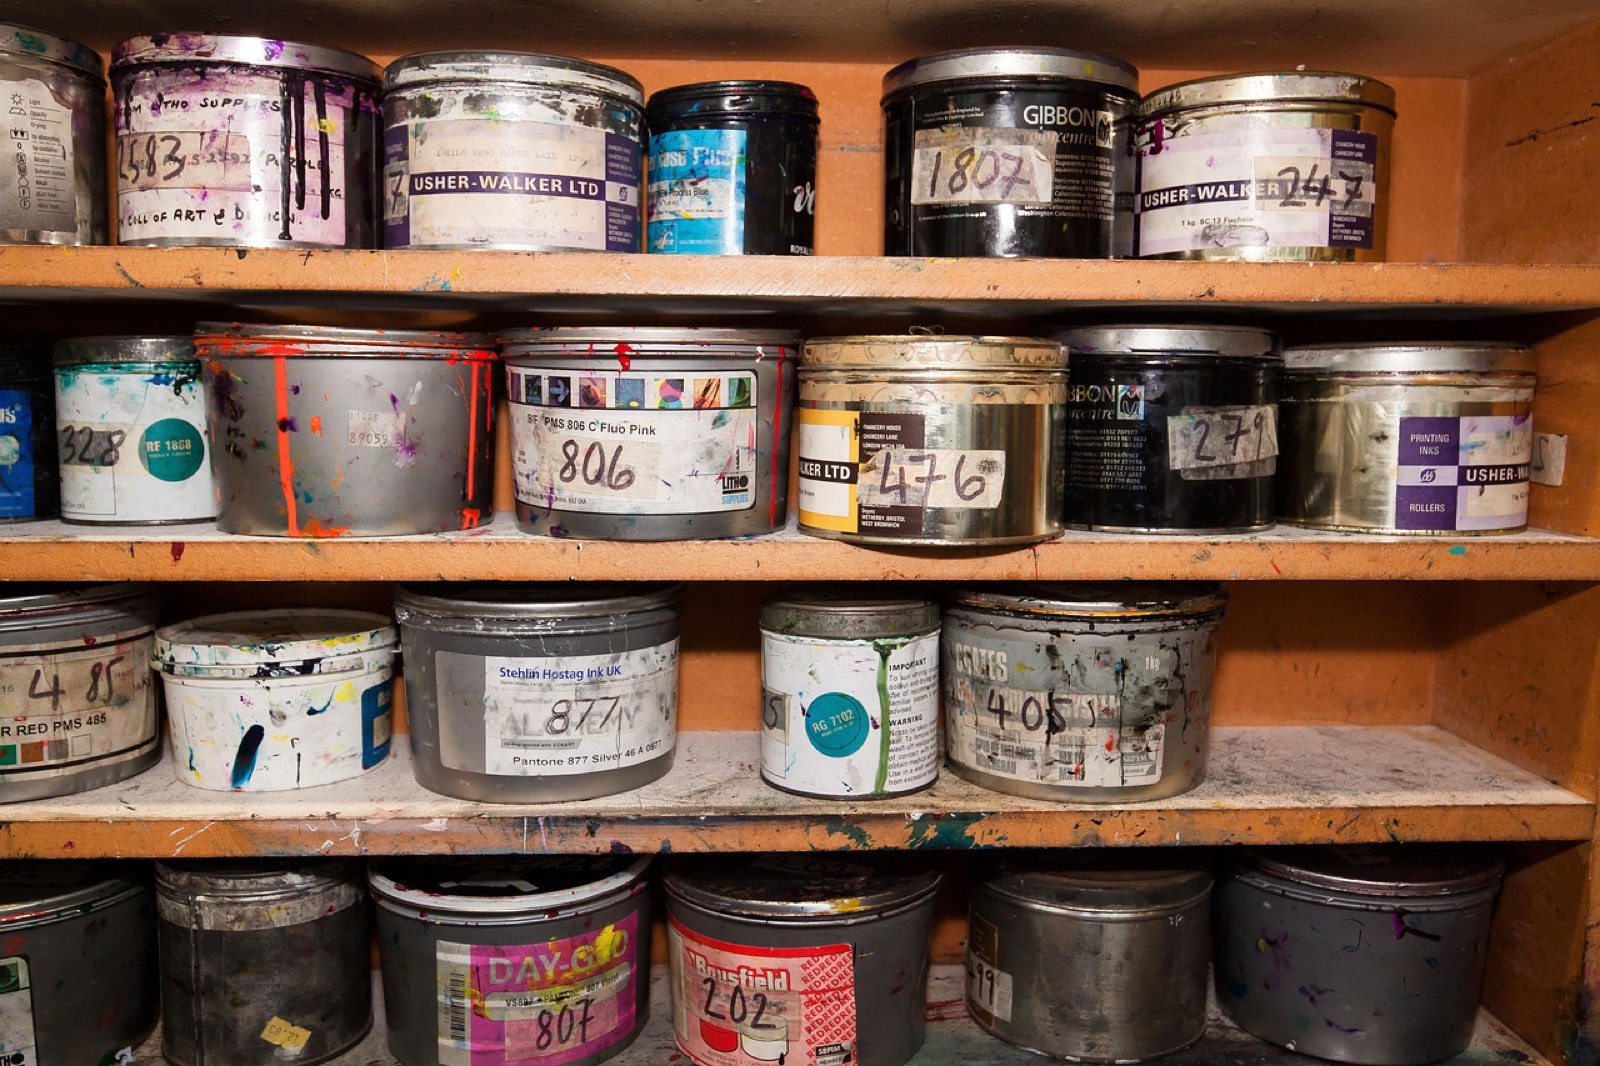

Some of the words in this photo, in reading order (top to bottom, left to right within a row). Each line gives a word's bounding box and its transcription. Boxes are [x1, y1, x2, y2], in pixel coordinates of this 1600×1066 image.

[1024, 105, 1095, 127] GIBBON
[930, 146, 1030, 200] 1807
[414, 174, 562, 192] USHER-WALKER
[569, 180, 598, 196] LTD
[1144, 180, 1279, 208] USHER-WALKER
[1278, 164, 1362, 210] 247
[154, 212, 167, 223] OF
[173, 208, 206, 222] ART
[544, 416, 564, 429] PMS
[567, 420, 585, 431] 806
[588, 422, 596, 432] C
[600, 422, 626, 434] Fluo
[630, 424, 656, 436] Pink
[1194, 412, 1264, 462] 279
[62, 424, 126, 466] 328
[146, 440, 160, 452] RF
[1410, 433, 1450, 443] PRINTING
[1419, 446, 1439, 455] INKS
[559, 438, 636, 490] 806
[824, 464, 851, 480] LTD
[722, 475, 749, 490] LITHO
[880, 452, 986, 506] 476
[722, 494, 748, 505] SUPPLIES
[1410, 504, 1445, 512] ROLLERS
[500, 666, 540, 680] Stehlin
[543, 669, 584, 681] Hostag
[587, 667, 603, 678] Ink
[606, 665, 622, 676] UK
[890, 657, 926, 671] IMPORTANT
[955, 642, 1008, 682] COATES
[1145, 655, 1161, 671] 1kg
[546, 695, 620, 734] 877
[812, 720, 828, 734] RG
[830, 709, 855, 726] 7102
[889, 714, 923, 726] WARNING
[988, 688, 1066, 734] 405
[16, 724, 48, 735] RED
[53, 719, 82, 732] PMS
[86, 714, 107, 726] 485
[513, 756, 564, 766] Pantone
[568, 756, 588, 765] 877
[592, 753, 622, 763] Silver
[490, 931, 628, 984] DAY-GO
[695, 956, 788, 991] Bousfield
[702, 977, 776, 1029] 202
[536, 998, 595, 1050] 807
